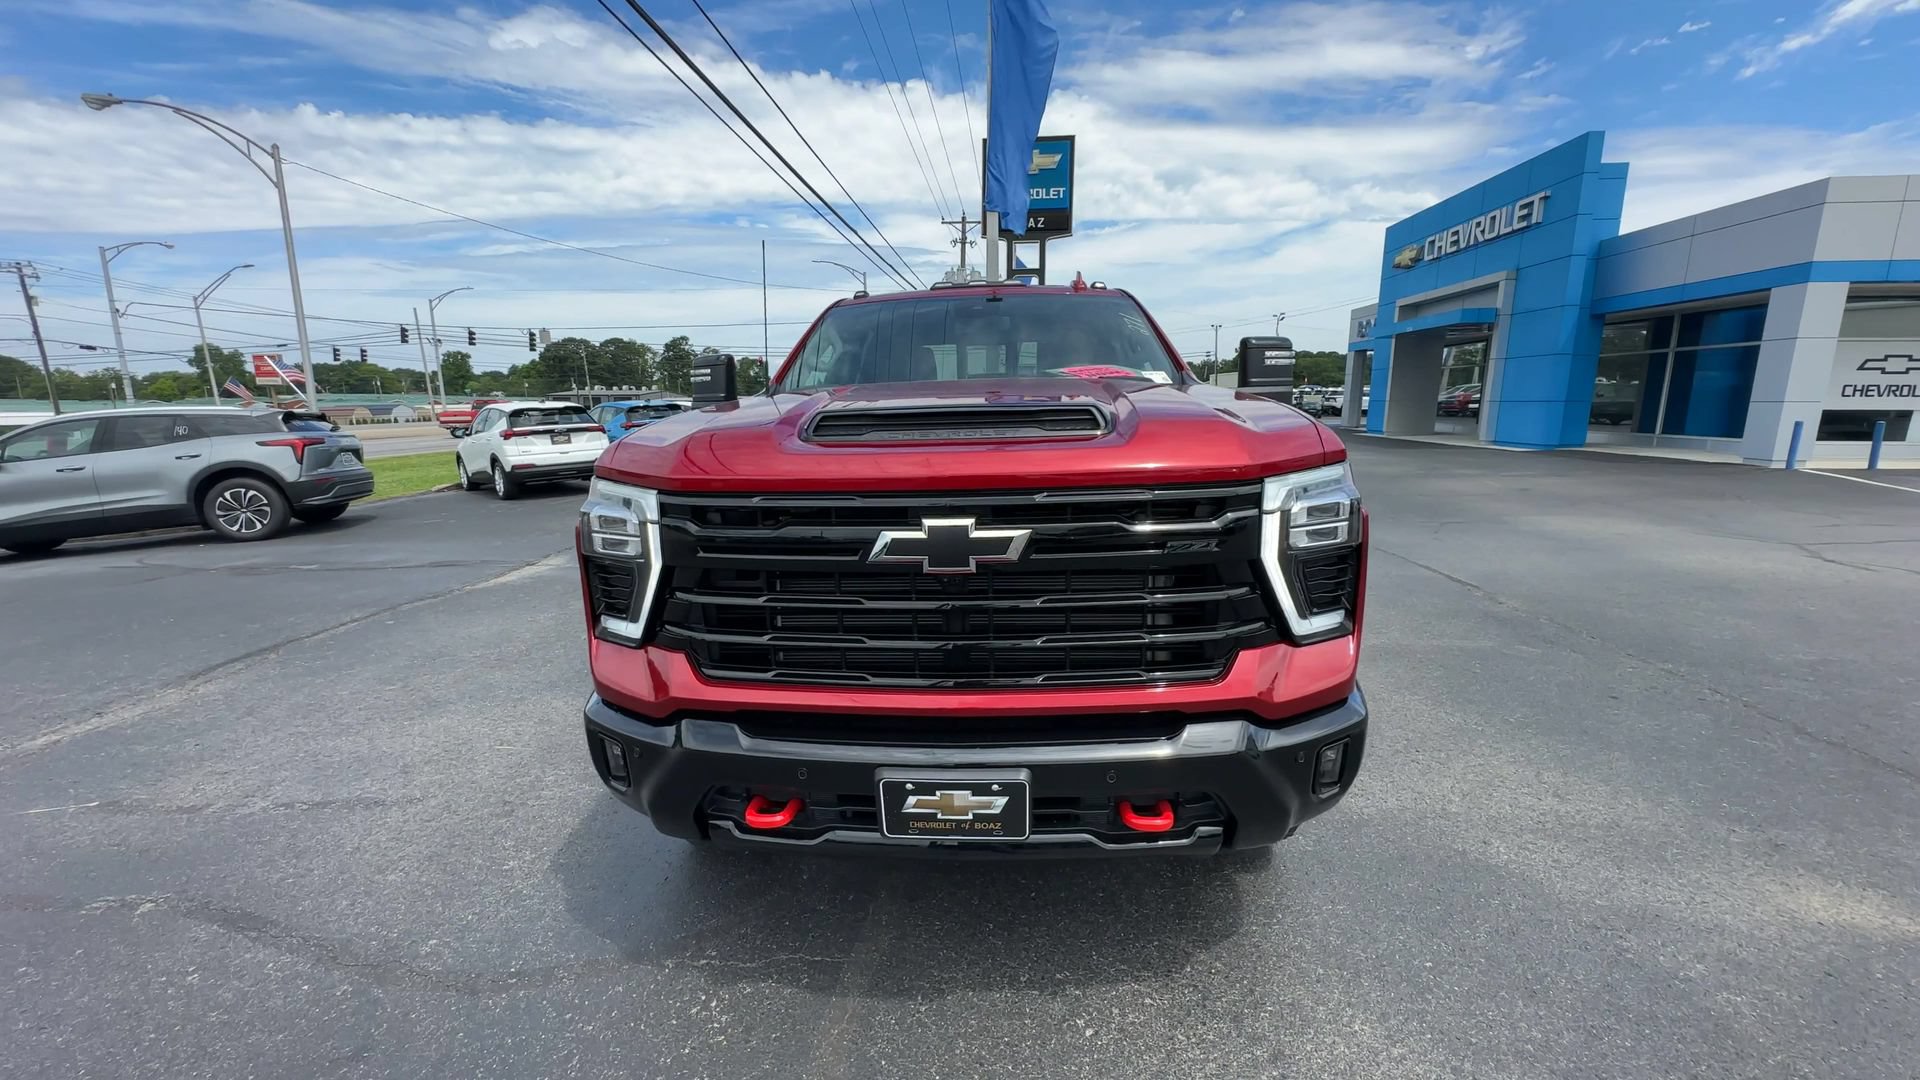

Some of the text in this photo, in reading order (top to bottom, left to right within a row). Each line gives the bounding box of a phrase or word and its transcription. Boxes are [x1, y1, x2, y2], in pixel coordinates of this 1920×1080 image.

[1423, 191, 1551, 262] CHEVROLET
[1841, 384, 1920, 398] CHEVROL
[909, 821, 1002, 830] CHEVROLET of BOAZ
